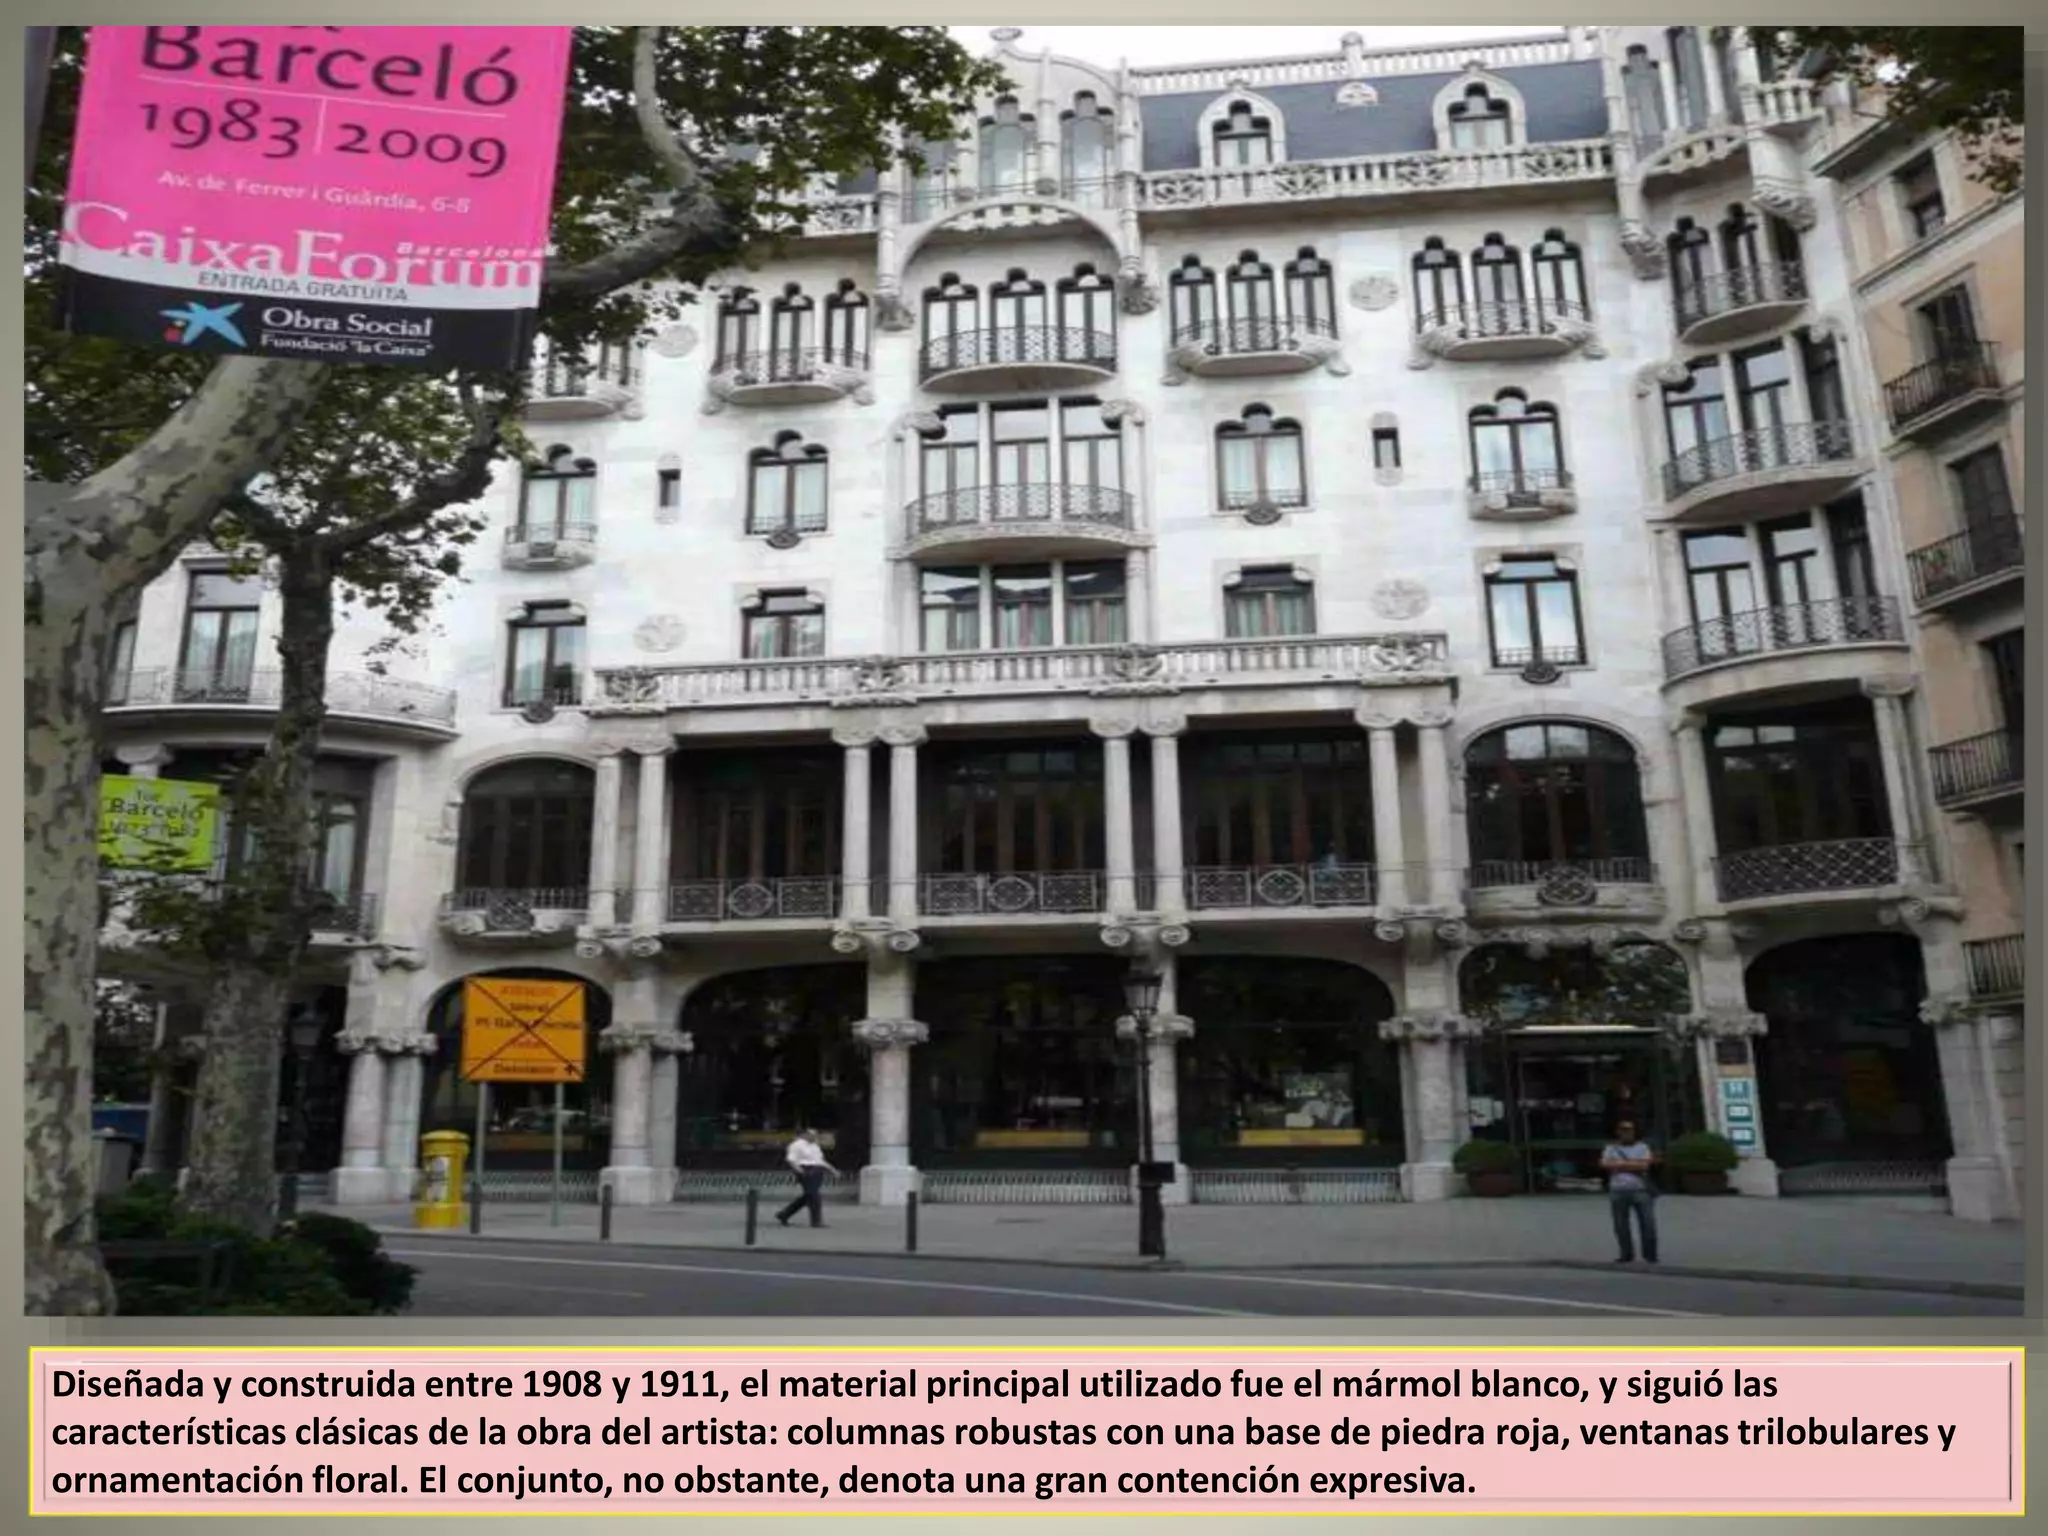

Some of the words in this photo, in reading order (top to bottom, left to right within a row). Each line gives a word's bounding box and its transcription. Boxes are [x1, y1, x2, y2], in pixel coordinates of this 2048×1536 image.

[140, 26, 519, 107] Barceló
[138, 97, 303, 160] 1983
[334, 122, 509, 178] 2009
[60, 200, 543, 290] CaixaForum
[197, 269, 301, 295] ENTRADA
[260, 332, 349, 352] Fundació
[261, 306, 341, 331] Obra
[347, 312, 434, 337] Social
